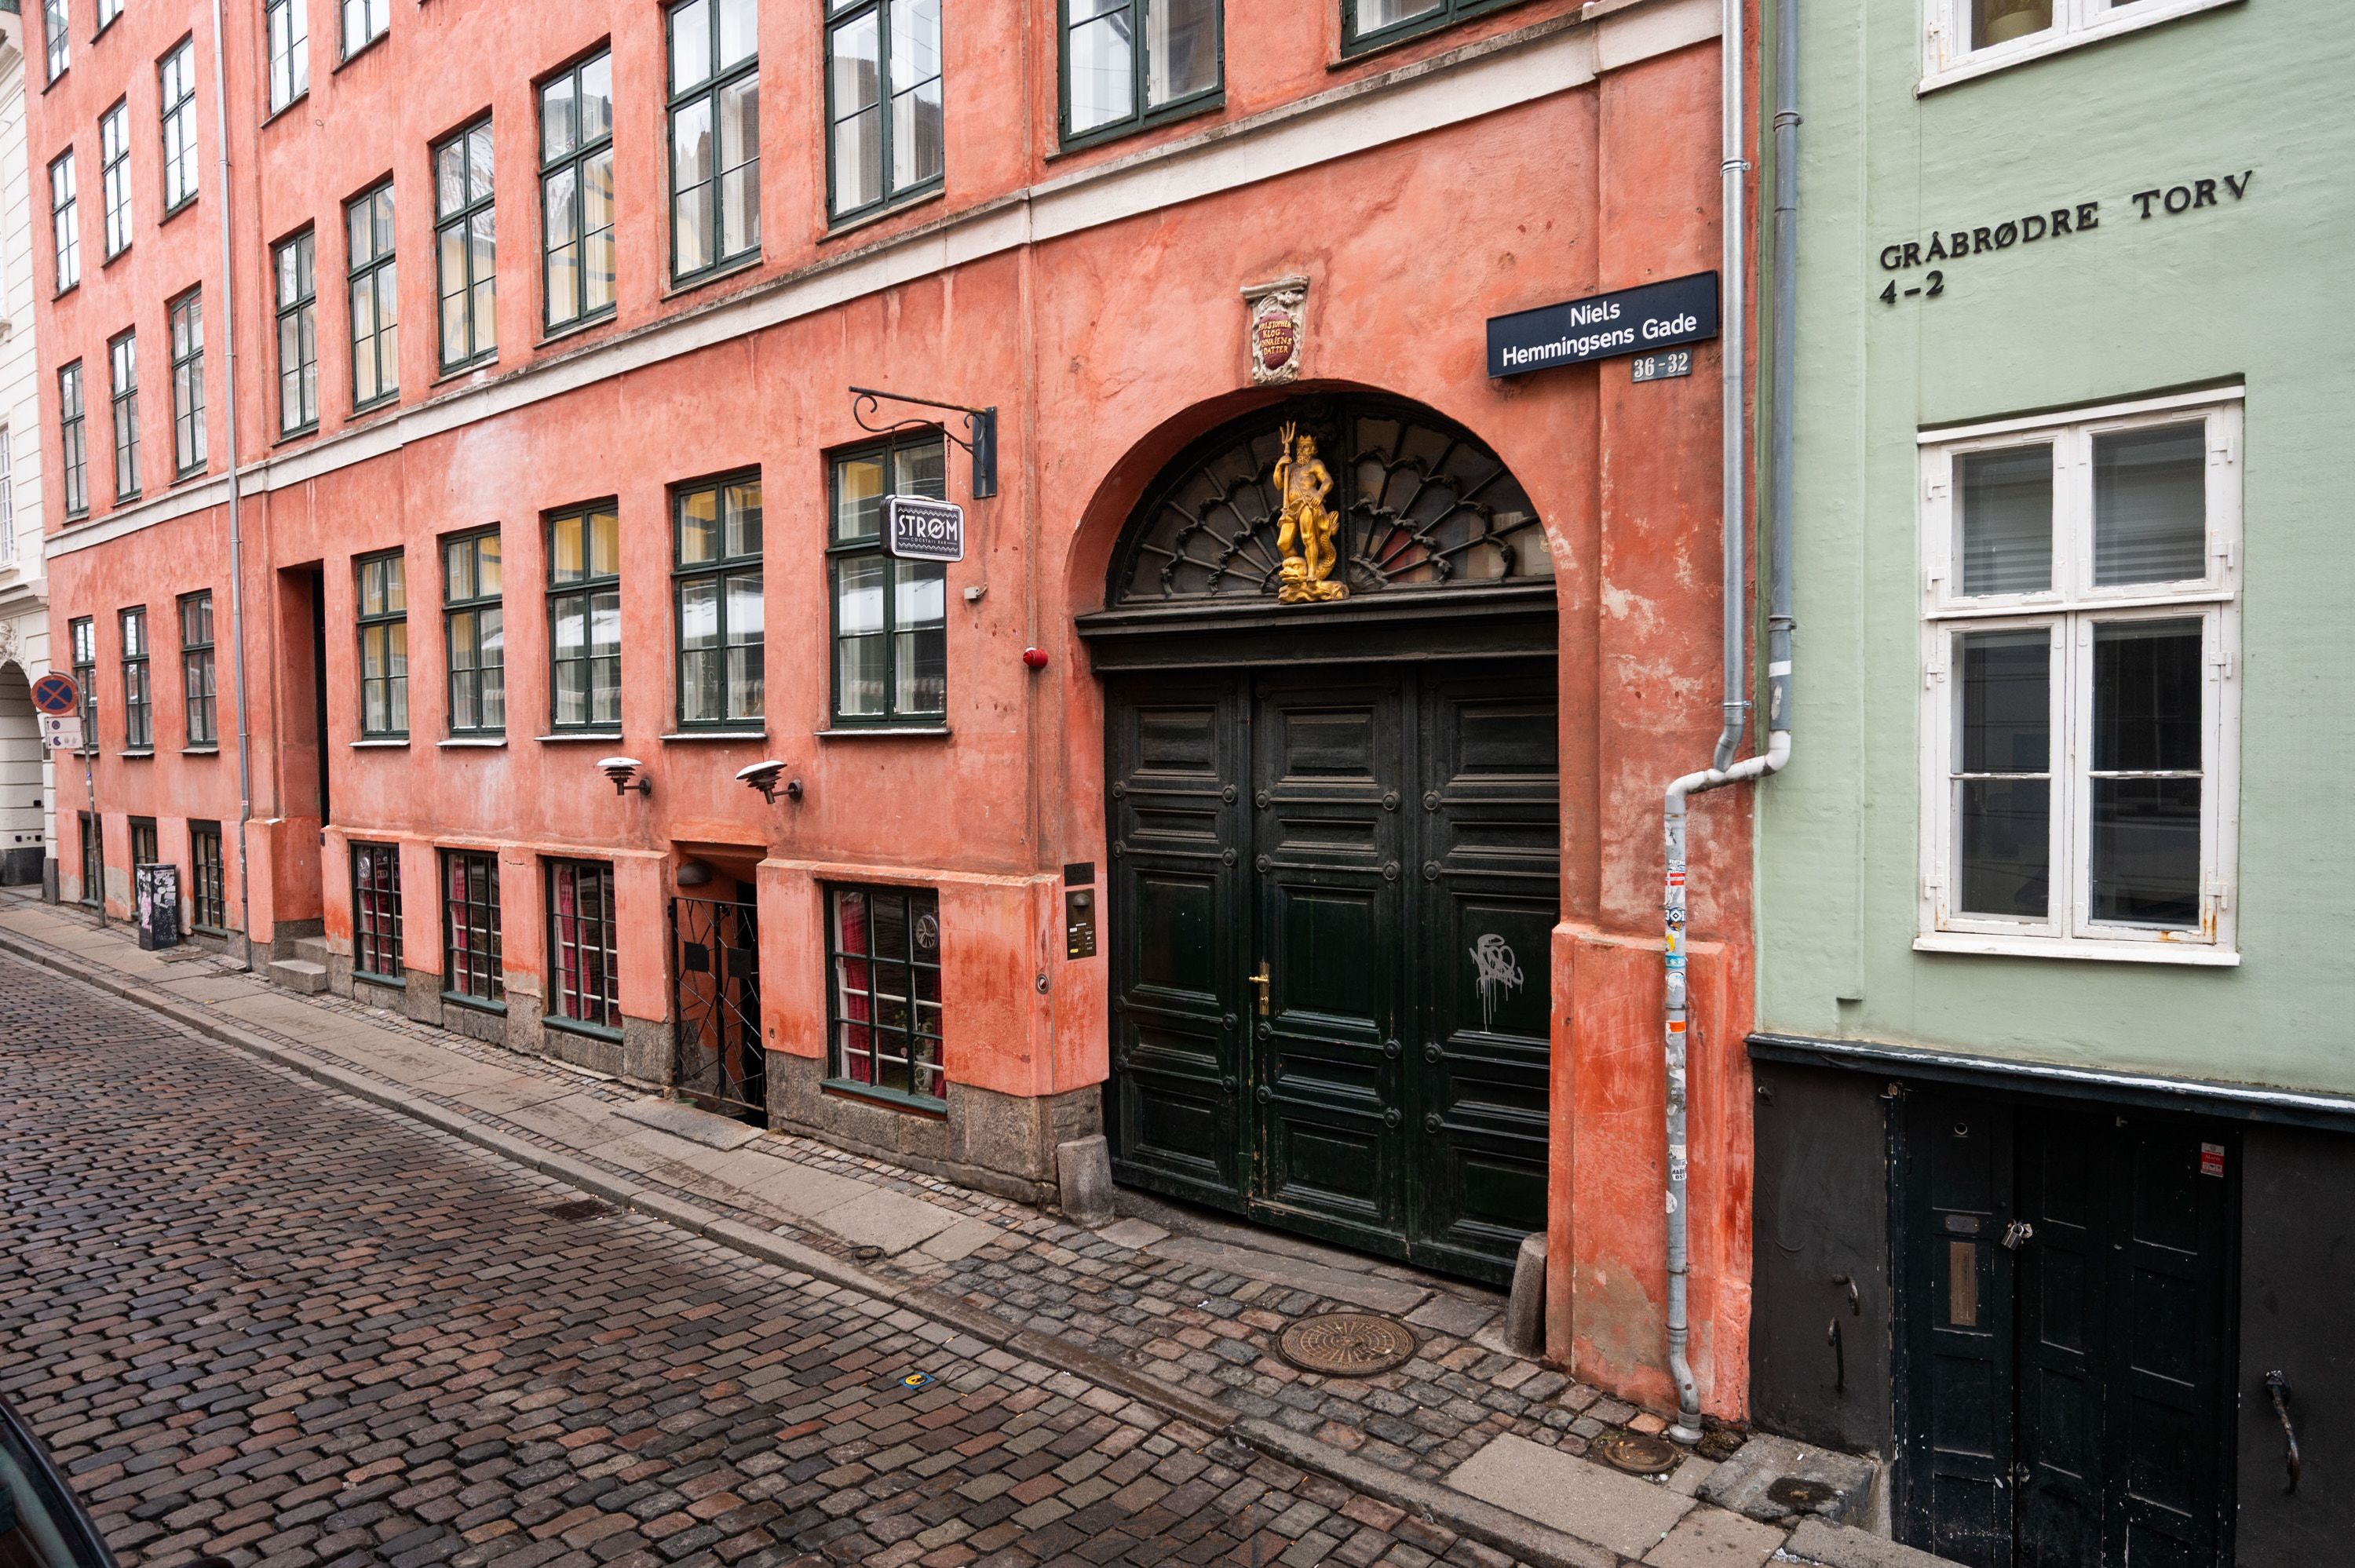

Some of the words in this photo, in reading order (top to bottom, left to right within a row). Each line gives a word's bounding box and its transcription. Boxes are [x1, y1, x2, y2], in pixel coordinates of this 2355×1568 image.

[1879, 201, 2100, 271] GRÅBRØDRE
[2132, 170, 2253, 219] TORV
[1570, 301, 1621, 327] Niels
[1264, 345, 1288, 355] DATTER
[1502, 326, 1635, 366] Hemmingsens
[1642, 313, 1697, 339] Gade
[898, 514, 958, 542] STRØM
